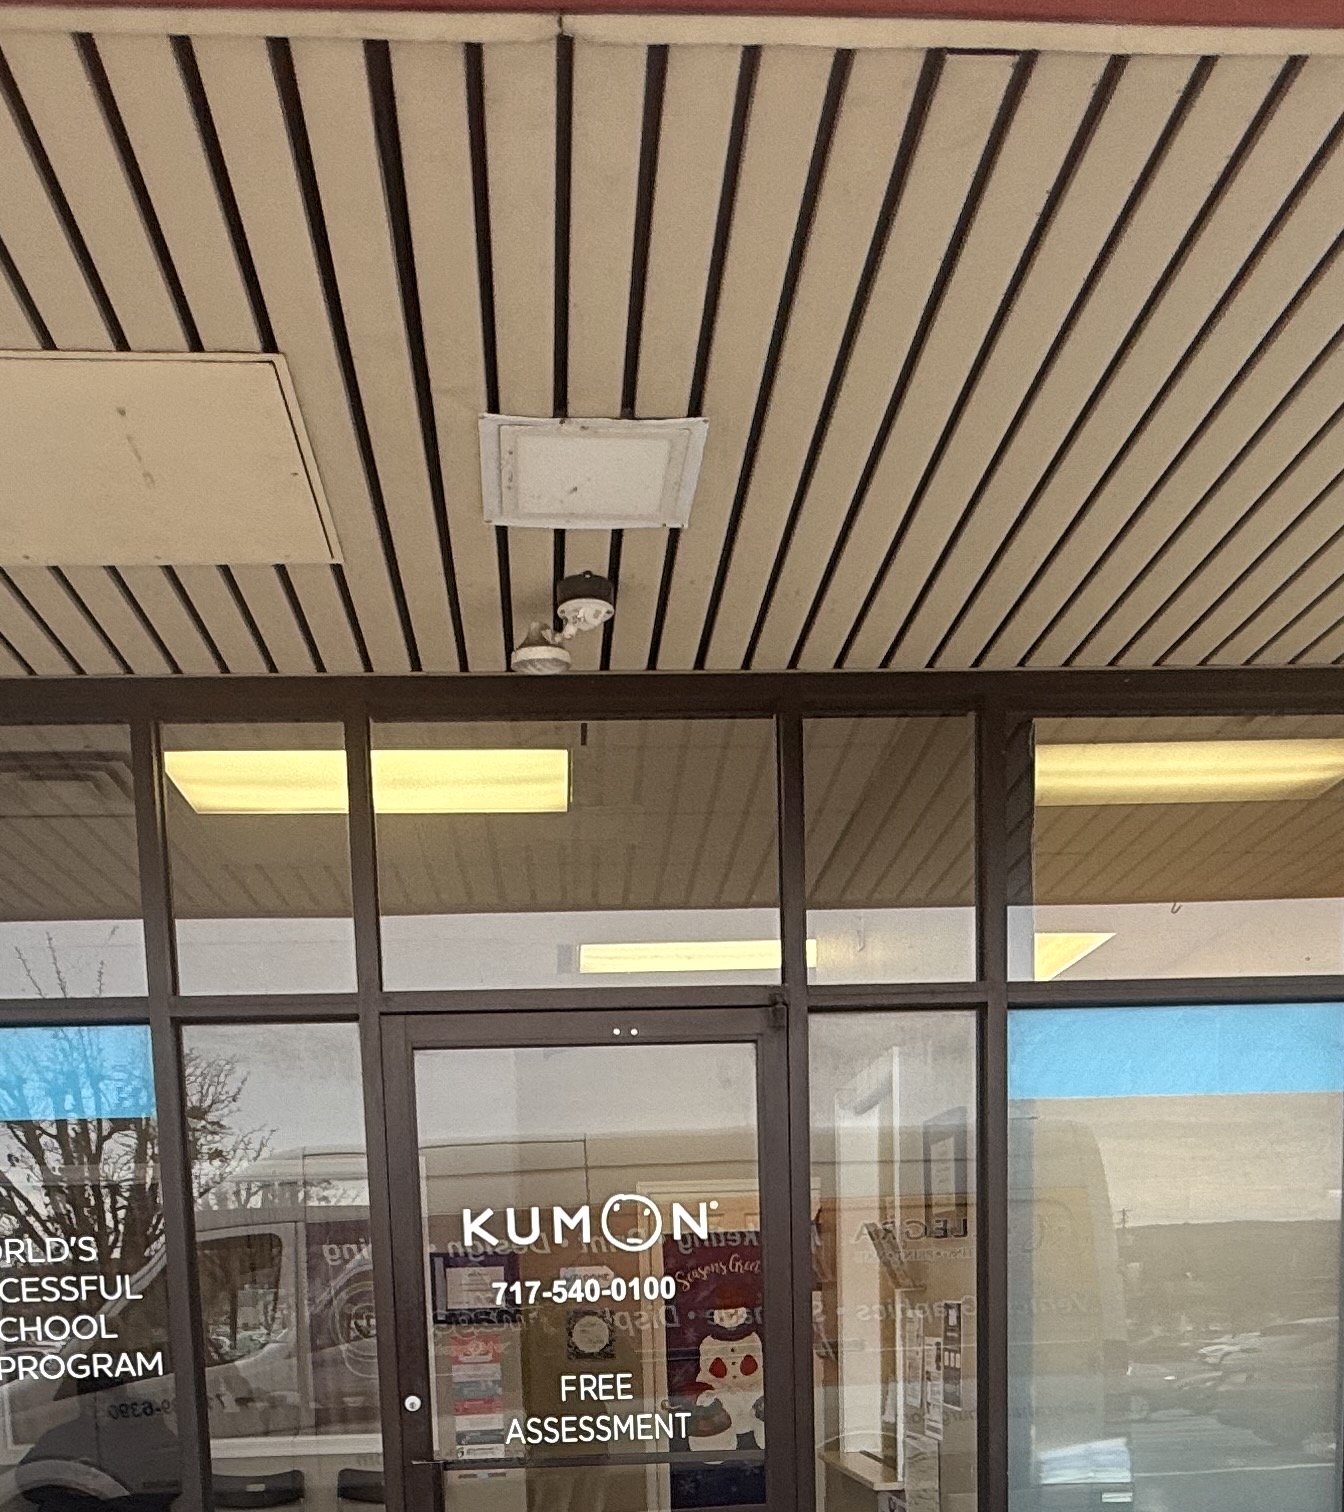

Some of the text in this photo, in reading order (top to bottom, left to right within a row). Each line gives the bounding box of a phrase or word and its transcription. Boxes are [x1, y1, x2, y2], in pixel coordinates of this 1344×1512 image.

[461, 1193, 716, 1252] KUMON
[491, 1276, 677, 1306] 717-540-0100
[560, 1373, 634, 1403] FREE
[505, 1412, 692, 1445] ASSESSMENT
